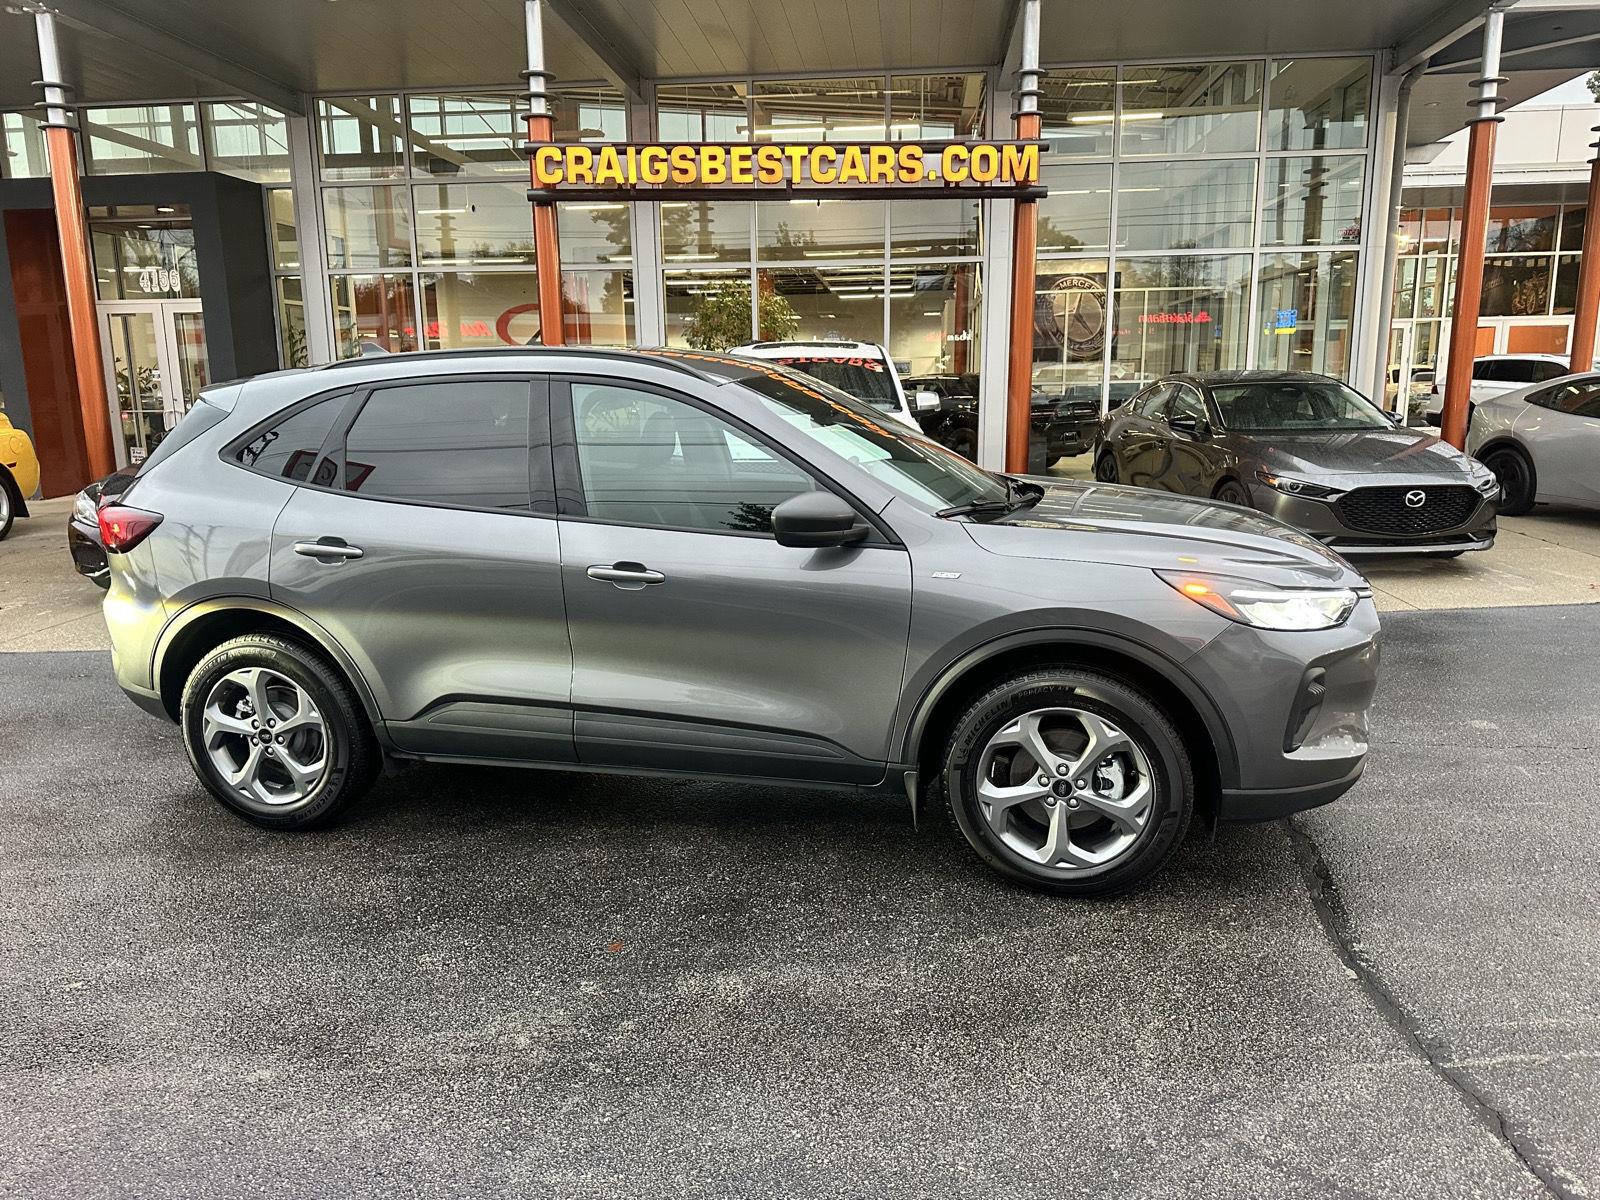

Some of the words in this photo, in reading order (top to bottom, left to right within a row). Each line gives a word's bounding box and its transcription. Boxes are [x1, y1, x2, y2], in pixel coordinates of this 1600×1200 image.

[535, 145, 1040, 185] CRAIGSBESTCARS.COM
[140, 269, 181, 292] 4156
[963, 699, 1010, 747] MICHELIN
